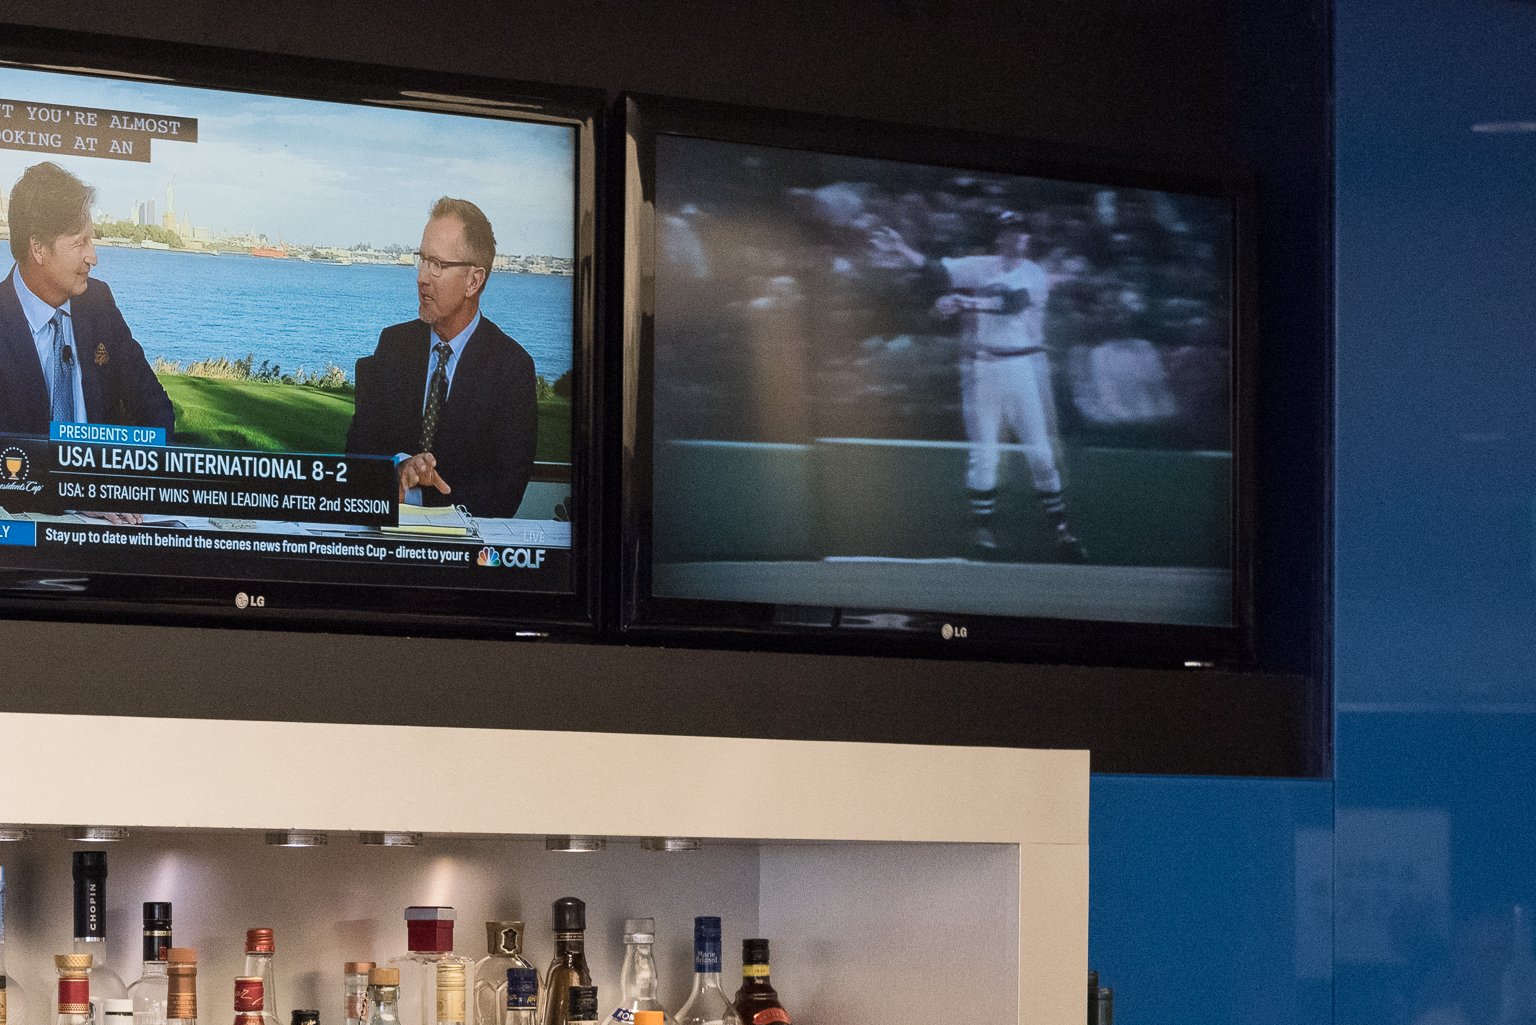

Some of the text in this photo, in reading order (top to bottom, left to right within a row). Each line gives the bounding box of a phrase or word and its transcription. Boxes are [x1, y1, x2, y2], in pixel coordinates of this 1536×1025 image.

[27, 106, 98, 126] YOU'RE
[110, 116, 181, 135] ALMOST
[74, 137, 98, 152] AT
[110, 141, 133, 155] AN
[59, 424, 156, 443] PRESIDENTS CUP
[58, 445, 347, 483] USA LEADS INTERNATIONAL 8-2
[58, 482, 389, 514] USA: 8 STRAIGHT WINS WHEN LEADING AFTER 2nd SESSION
[45, 528, 70, 544] Stay
[72, 531, 86, 546] up
[88, 531, 100, 543] to
[102, 532, 127, 545] date
[129, 533, 152, 546] with
[154, 534, 192, 548] behind
[194, 536, 212, 549] the
[214, 539, 251, 551] scenes
[253, 541, 280, 552] news
[282, 540, 308, 554] from
[309, 542, 364, 557] Presidents
[366, 544, 386, 560] Cup
[395, 546, 426, 560] direct
[428, 548, 438, 560] to
[440, 551, 463, 563] your
[502, 548, 546, 568] GOLF
[89, 883, 97, 931] CHOPIN
